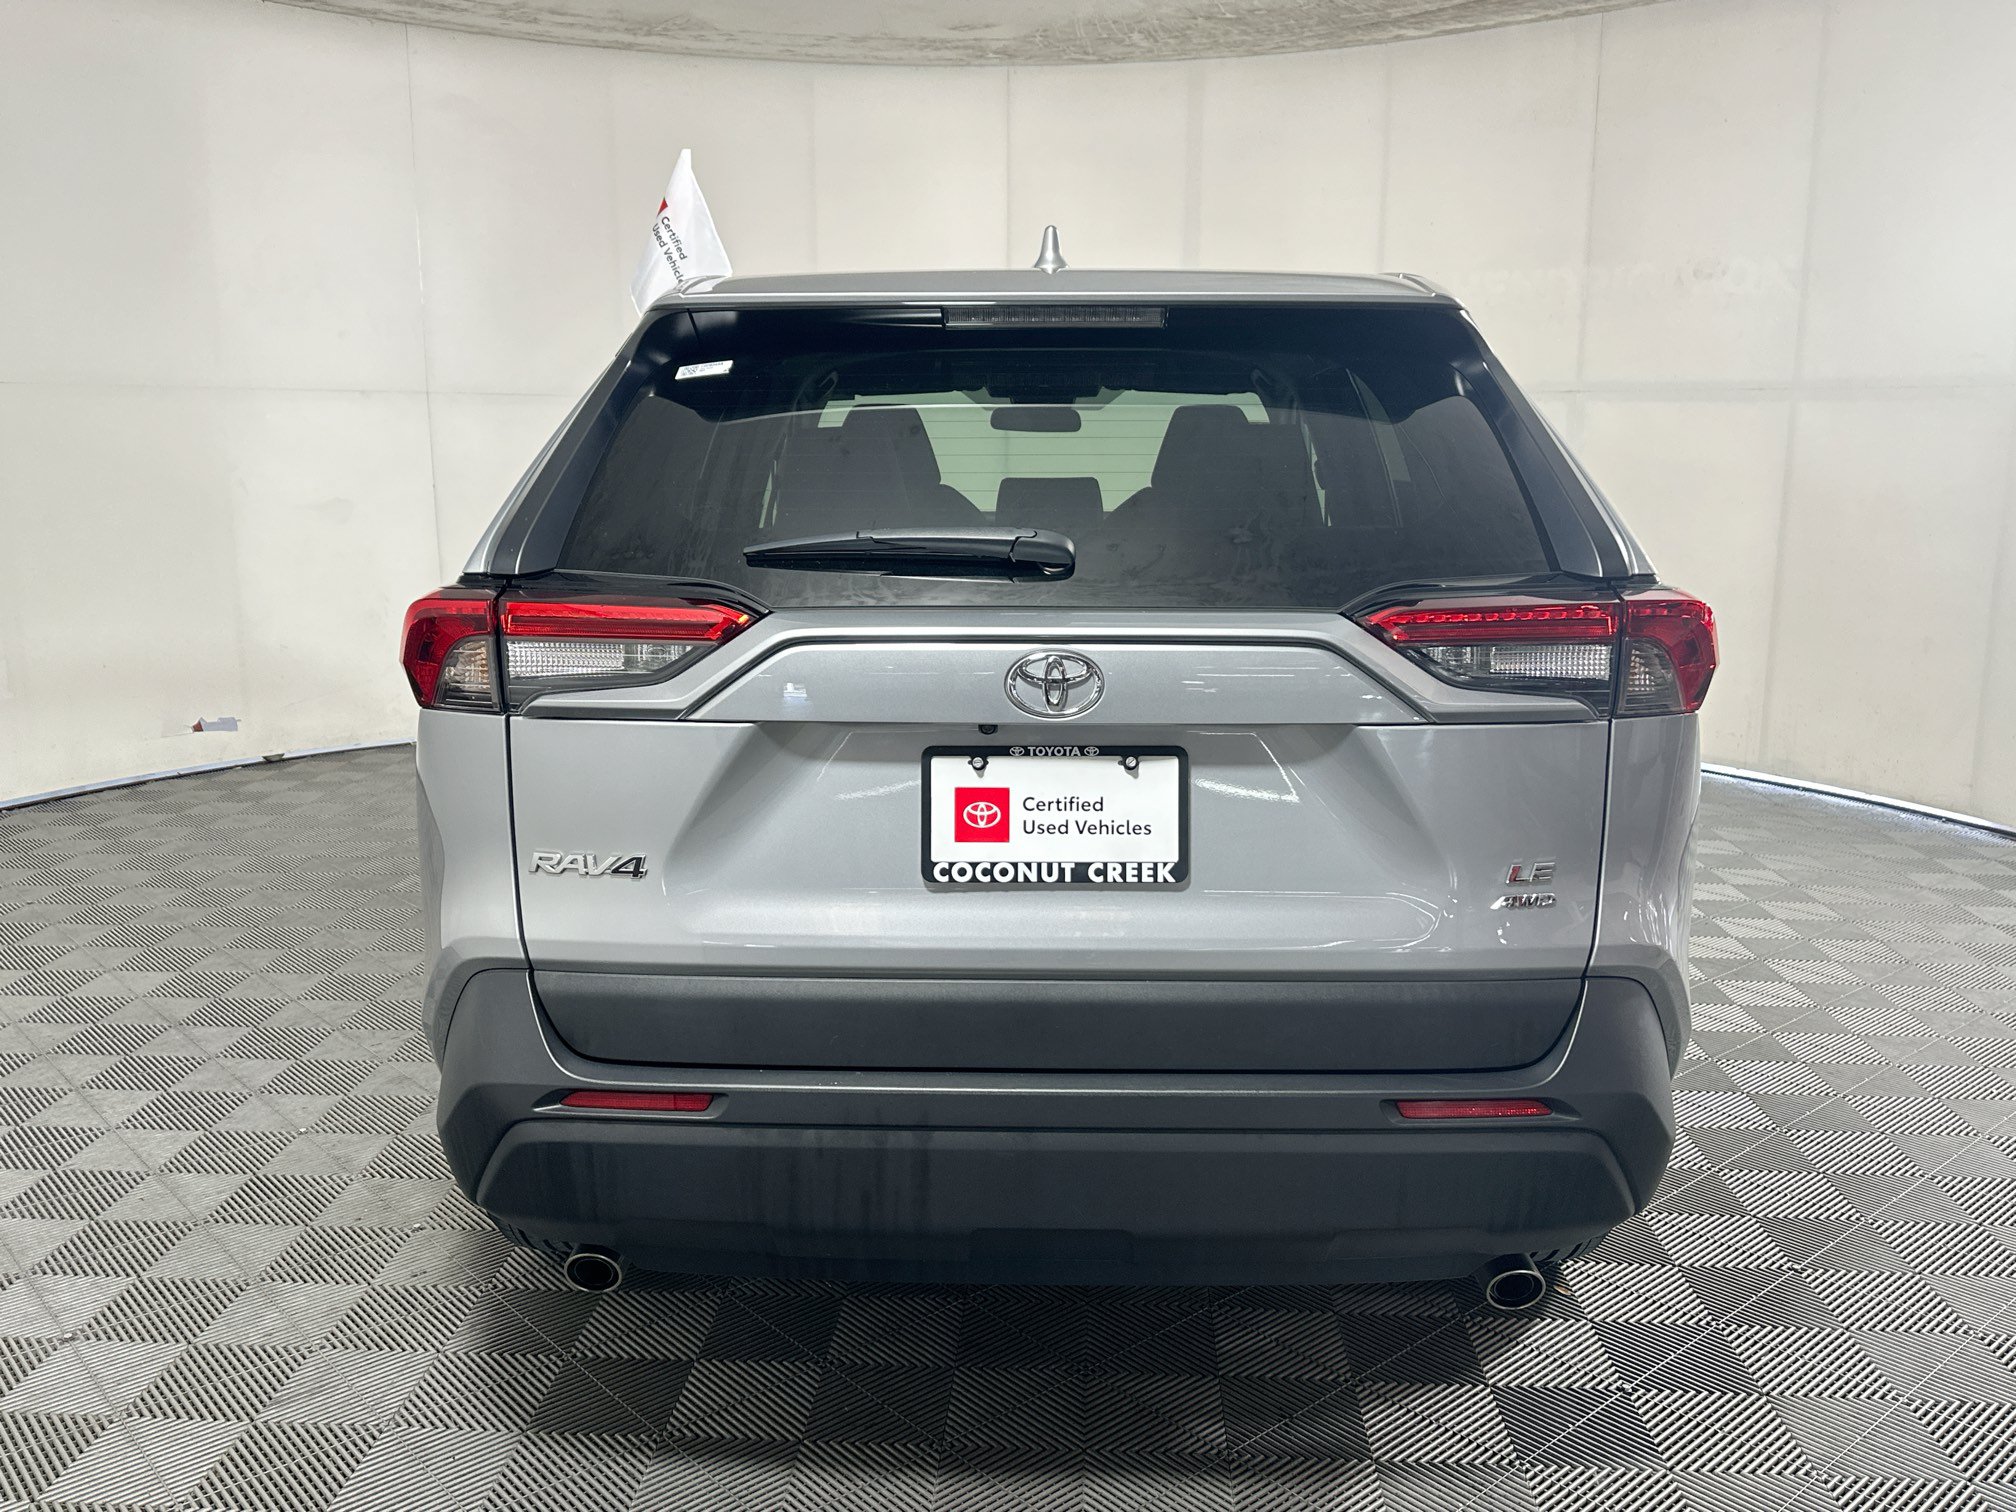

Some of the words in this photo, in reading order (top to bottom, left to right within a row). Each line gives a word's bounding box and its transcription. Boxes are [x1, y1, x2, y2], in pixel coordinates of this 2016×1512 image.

[652, 223, 668, 248] Used
[661, 216, 688, 260] Certified
[1027, 746, 1081, 757] TOYOTA
[1022, 796, 1104, 812] Certified
[1022, 819, 1069, 835] Used
[1075, 819, 1152, 836] Vehicles
[528, 851, 648, 880] RAV4
[933, 861, 1075, 883] COCONUT
[1087, 861, 1176, 883] CREEK
[1505, 862, 1556, 885] LE
